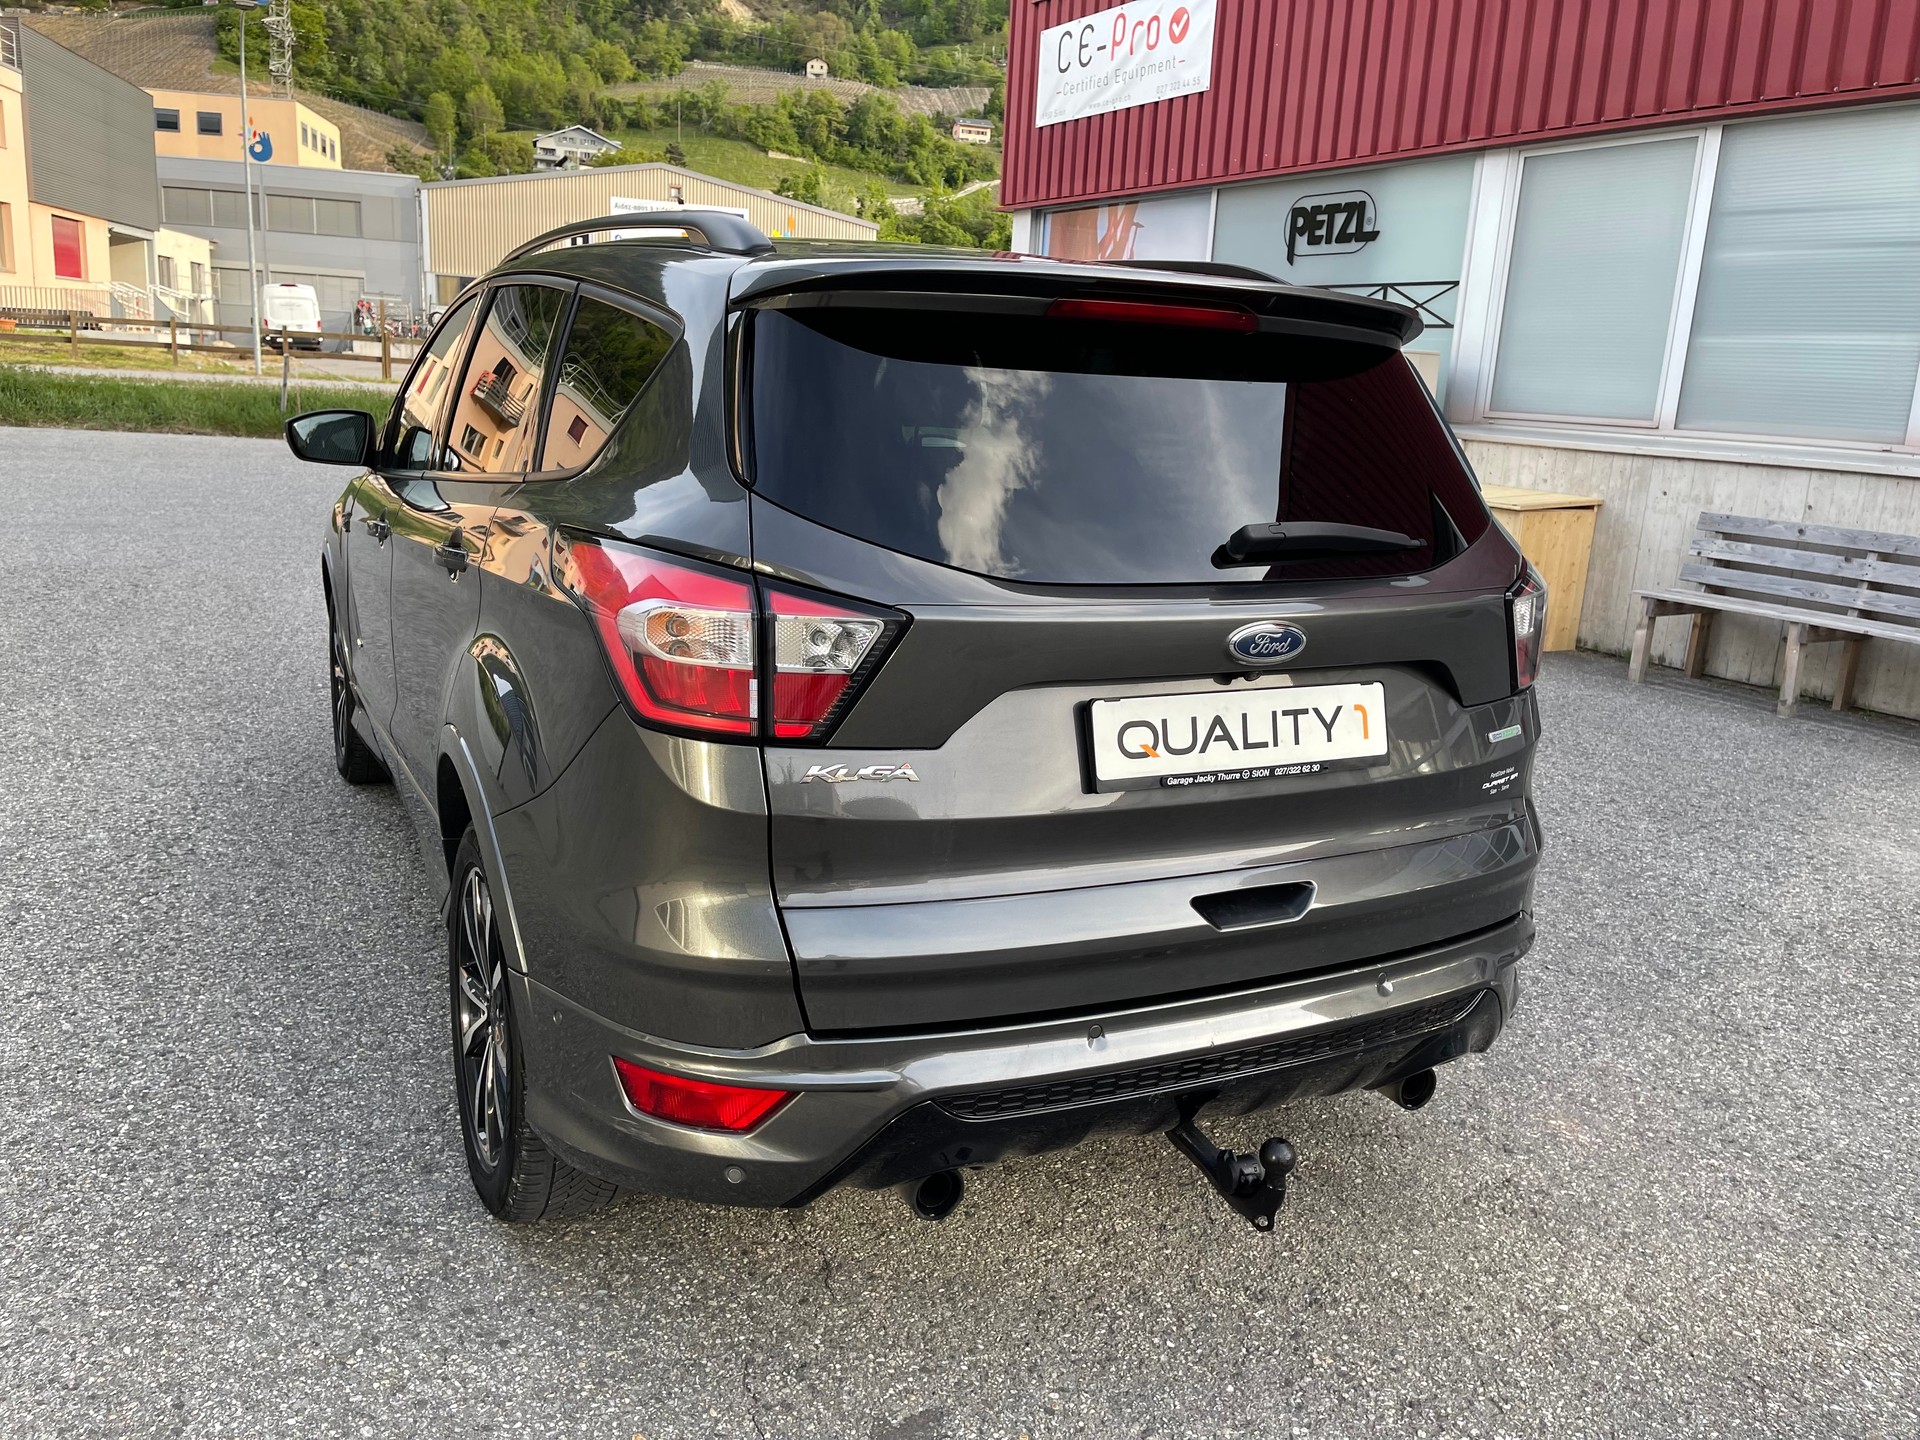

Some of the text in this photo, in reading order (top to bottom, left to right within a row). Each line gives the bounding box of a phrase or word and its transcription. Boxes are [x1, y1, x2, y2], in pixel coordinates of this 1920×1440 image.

[1286, 200, 1381, 267] PETZL
[1250, 632, 1291, 655] Ford
[1117, 704, 1344, 760] QUALITY
[1167, 763, 1321, 786] Garage Jacky Thurre SION 027/322 62 30
